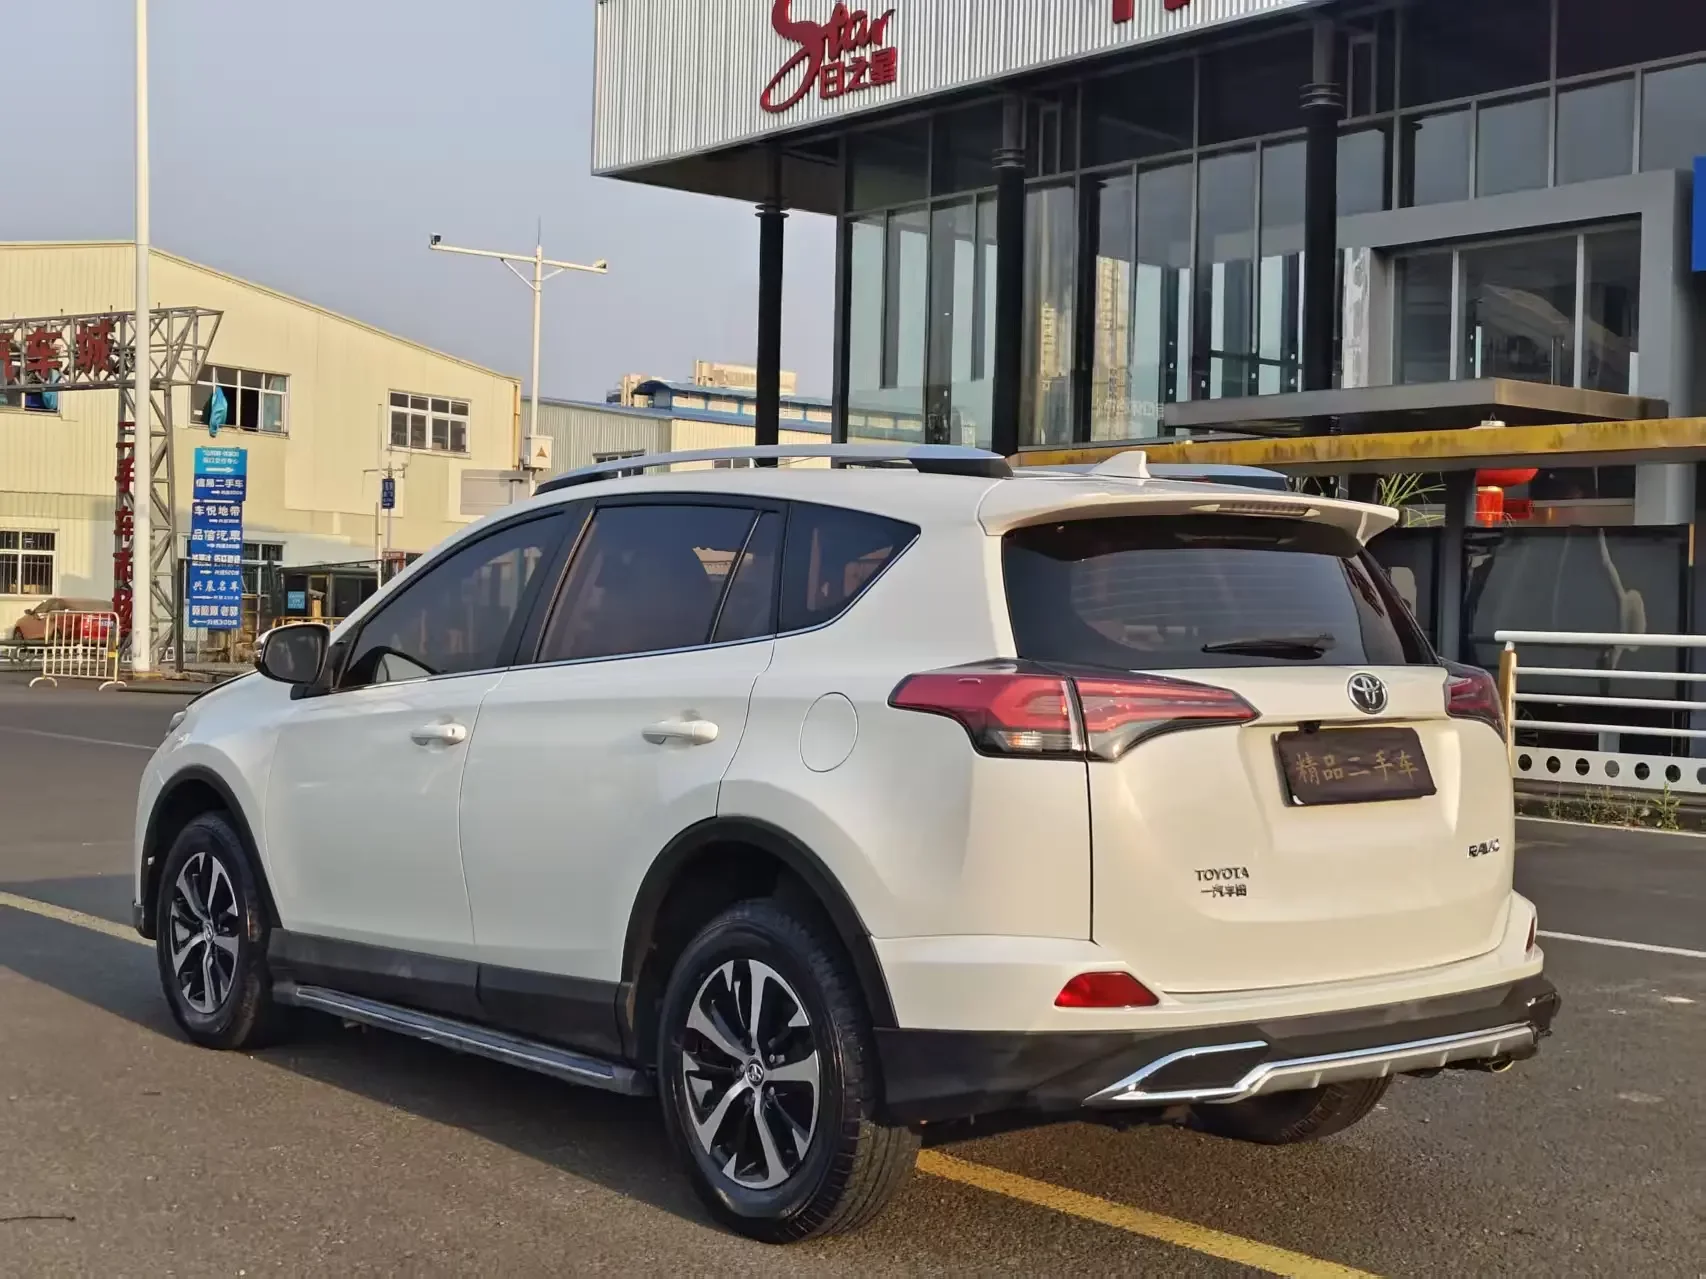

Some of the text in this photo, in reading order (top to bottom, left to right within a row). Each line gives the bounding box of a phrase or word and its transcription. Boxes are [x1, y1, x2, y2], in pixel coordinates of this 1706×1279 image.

[820, 47, 897, 100] 日之星
[194, 505, 240, 516] 车悦地带
[1296, 750, 1419, 785] 精品二手车
[1194, 866, 1249, 881] TOYOTA
